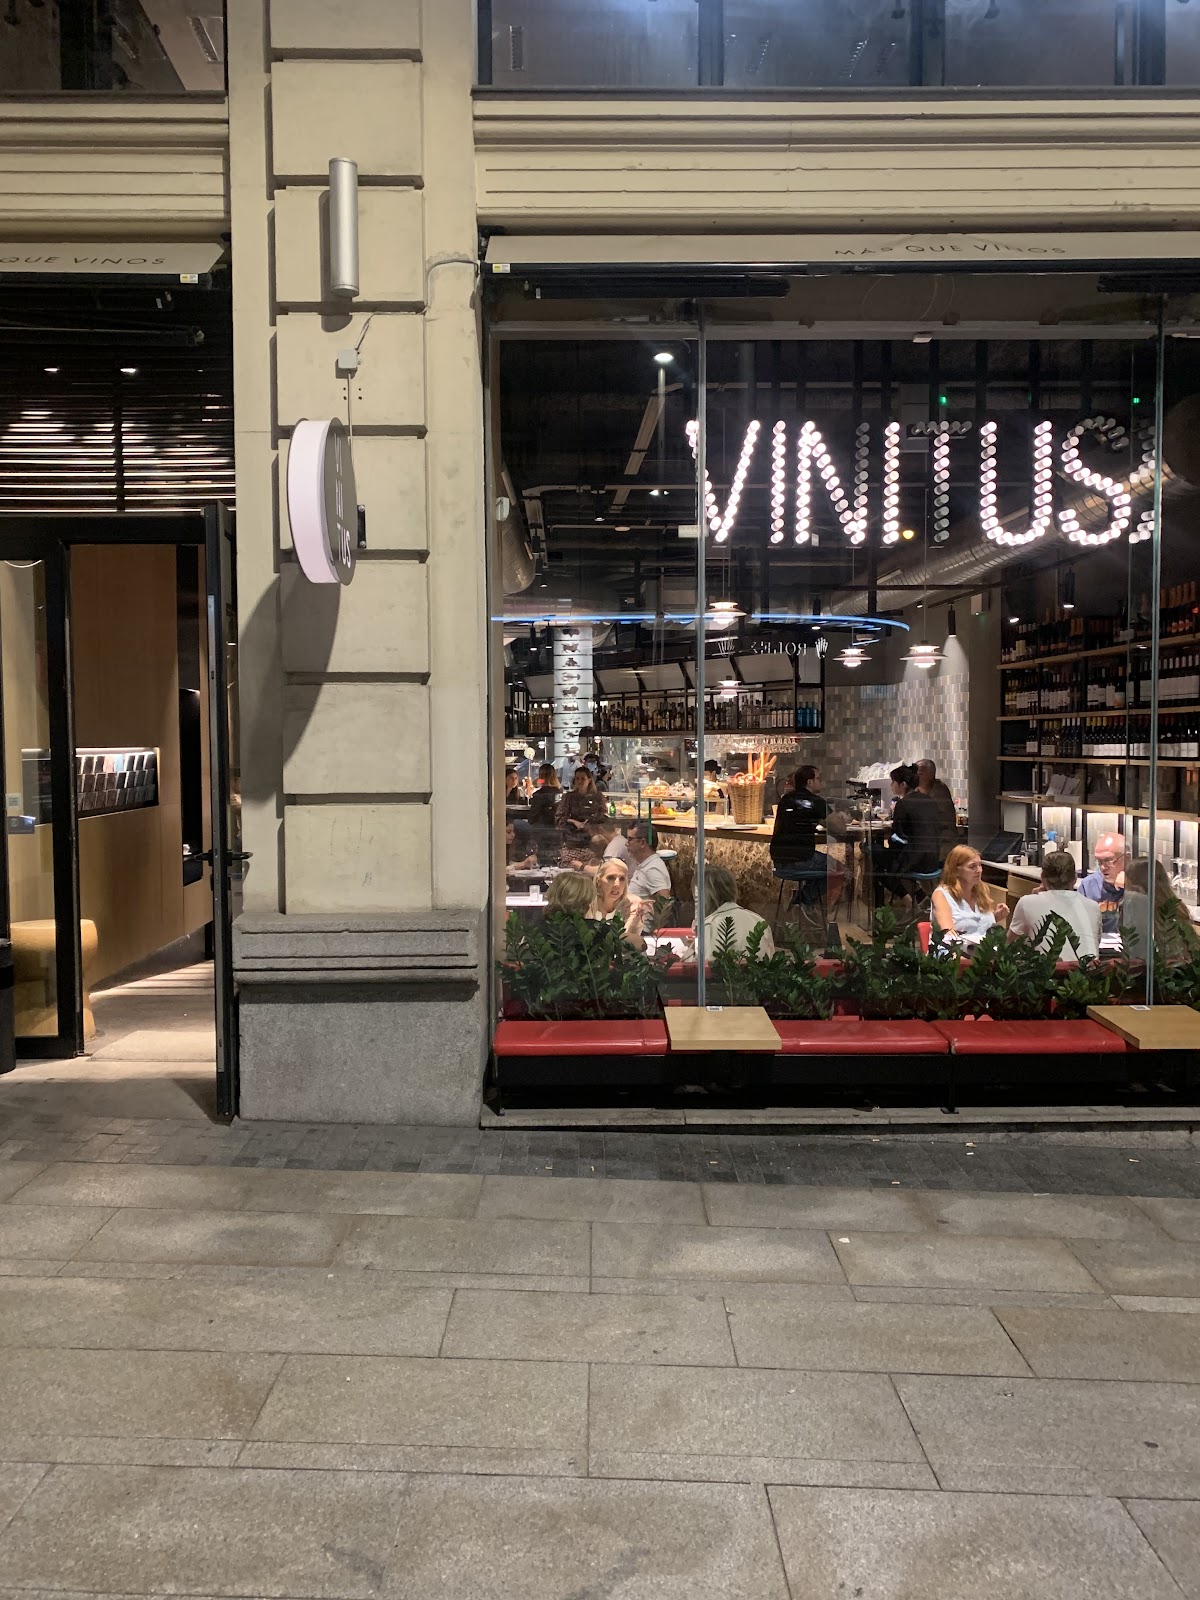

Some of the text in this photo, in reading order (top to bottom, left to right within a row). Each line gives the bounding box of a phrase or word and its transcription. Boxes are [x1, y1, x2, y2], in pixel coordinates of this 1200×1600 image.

[905, 244, 964, 252] QUE
[973, 244, 1066, 254] VINOS
[0, 257, 167, 265] QUE VINOS
[686, 414, 1132, 546] VINITUS
